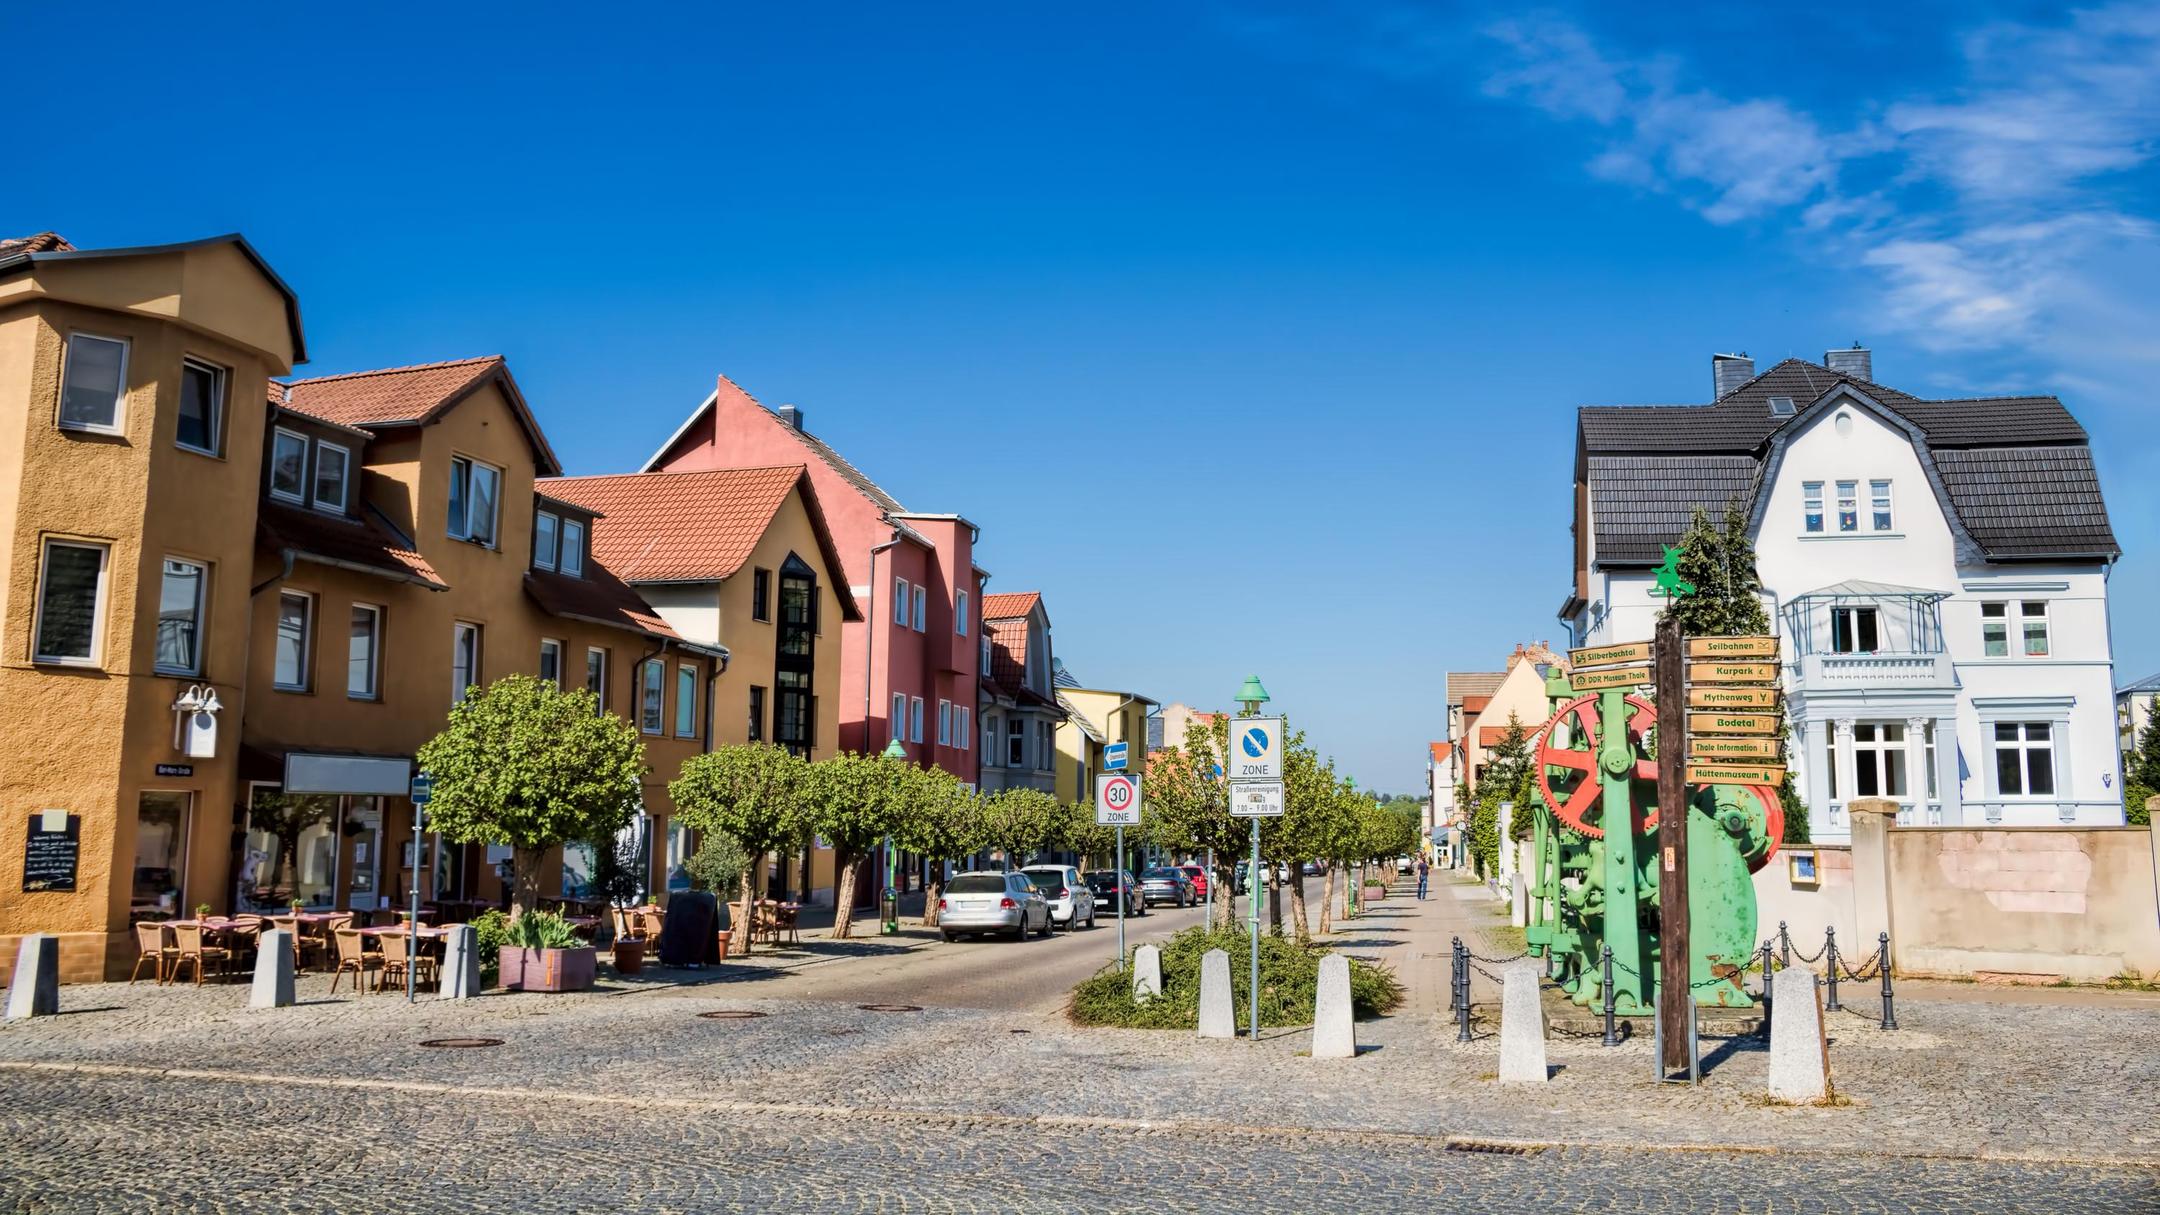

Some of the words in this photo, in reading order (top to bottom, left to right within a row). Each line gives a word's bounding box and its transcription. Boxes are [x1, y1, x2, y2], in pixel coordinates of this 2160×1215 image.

[1708, 642, 1754, 651] Seilbahnen
[1587, 648, 1636, 661] Silberbachtal
[1716, 667, 1753, 676] Kurpark
[1588, 676, 1601, 684] DDR
[1704, 693, 1753, 702] Mythenweg
[1717, 718, 1755, 727] Bodetal
[1696, 743, 1715, 751] Thale
[1717, 743, 1758, 752] Information
[1242, 764, 1269, 775] ZONE
[1695, 769, 1760, 779] Hüttenmuseum
[1110, 787, 1127, 802] 30
[1107, 812, 1129, 822] ZONE
